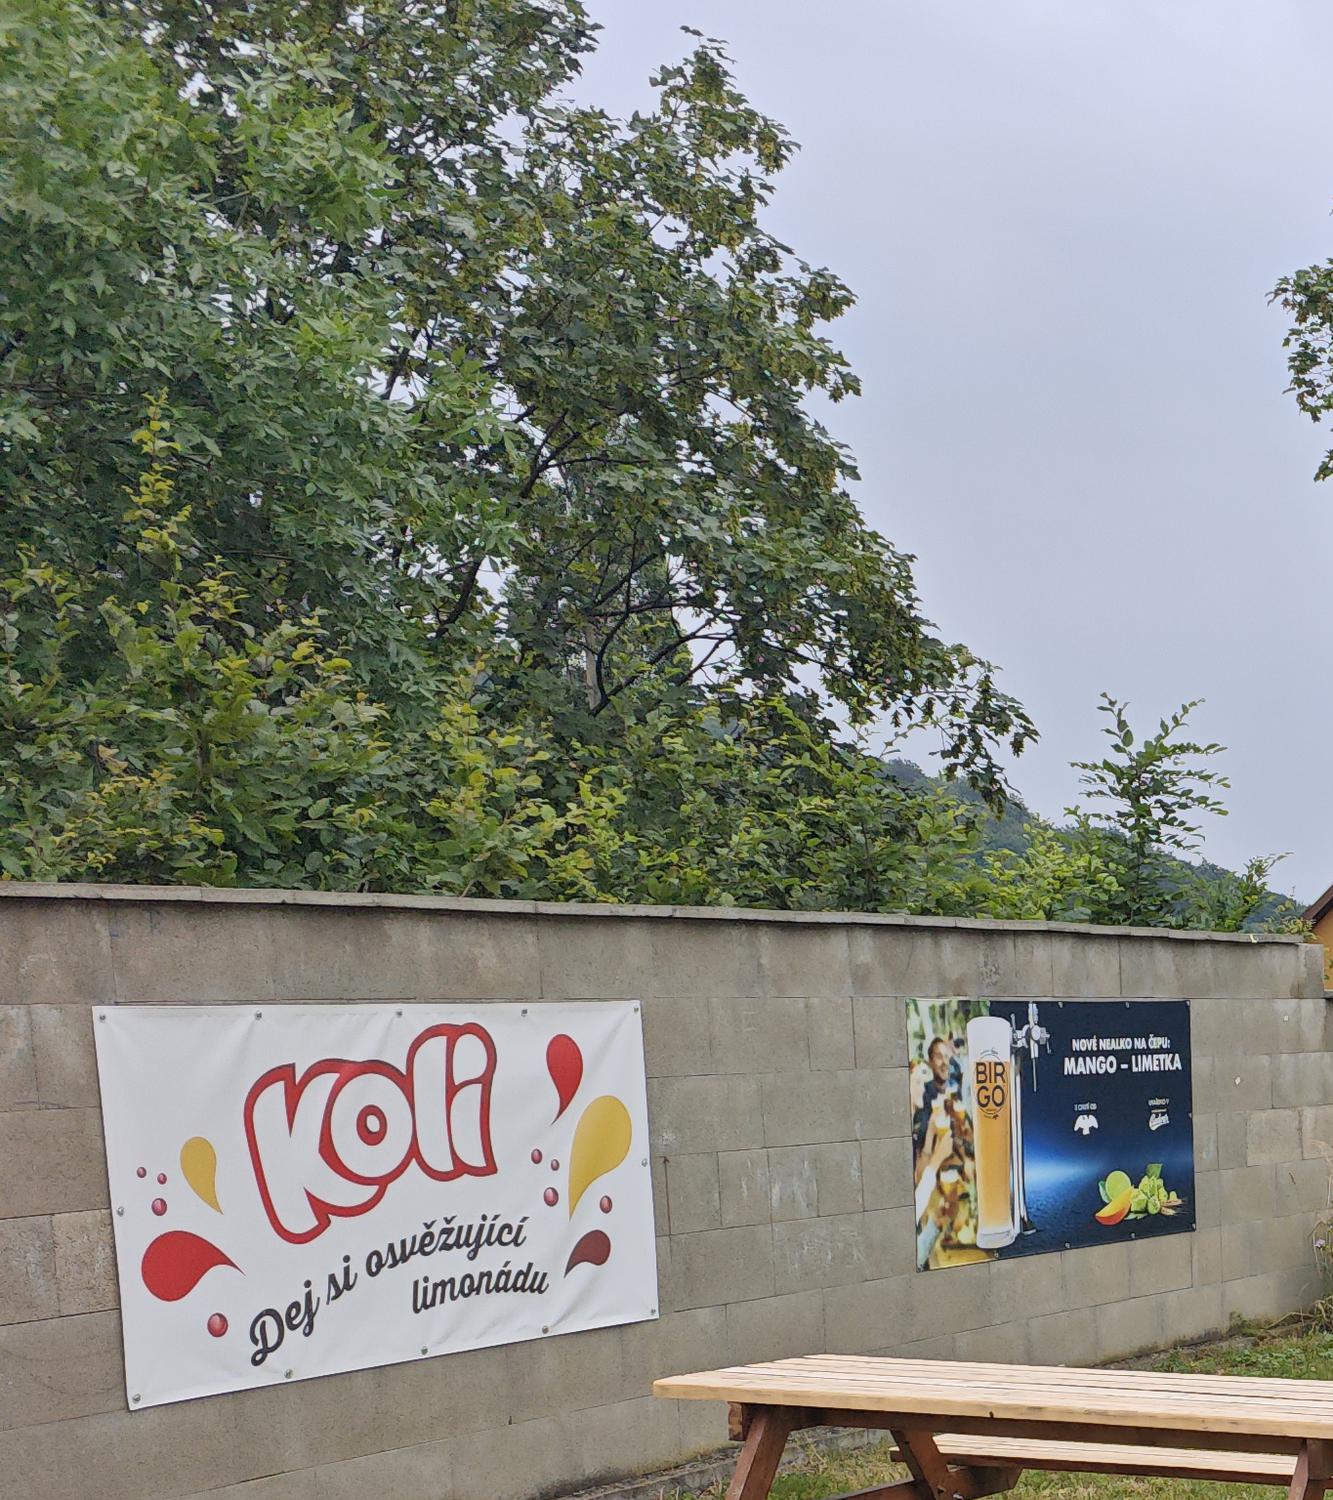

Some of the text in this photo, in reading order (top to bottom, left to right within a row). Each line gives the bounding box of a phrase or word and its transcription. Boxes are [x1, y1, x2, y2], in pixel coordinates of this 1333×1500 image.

[1072, 1034, 1171, 1052] NOVÉ NEALKO NA ČEPU:
[976, 1061, 1006, 1083] BIR
[1064, 1055, 1117, 1076] MANGO
[1131, 1053, 1182, 1073] LIMETKA
[976, 1085, 1005, 1107] GO
[249, 1214, 528, 1366] Dej si osvěžující
[412, 1262, 549, 1314] limonádu
